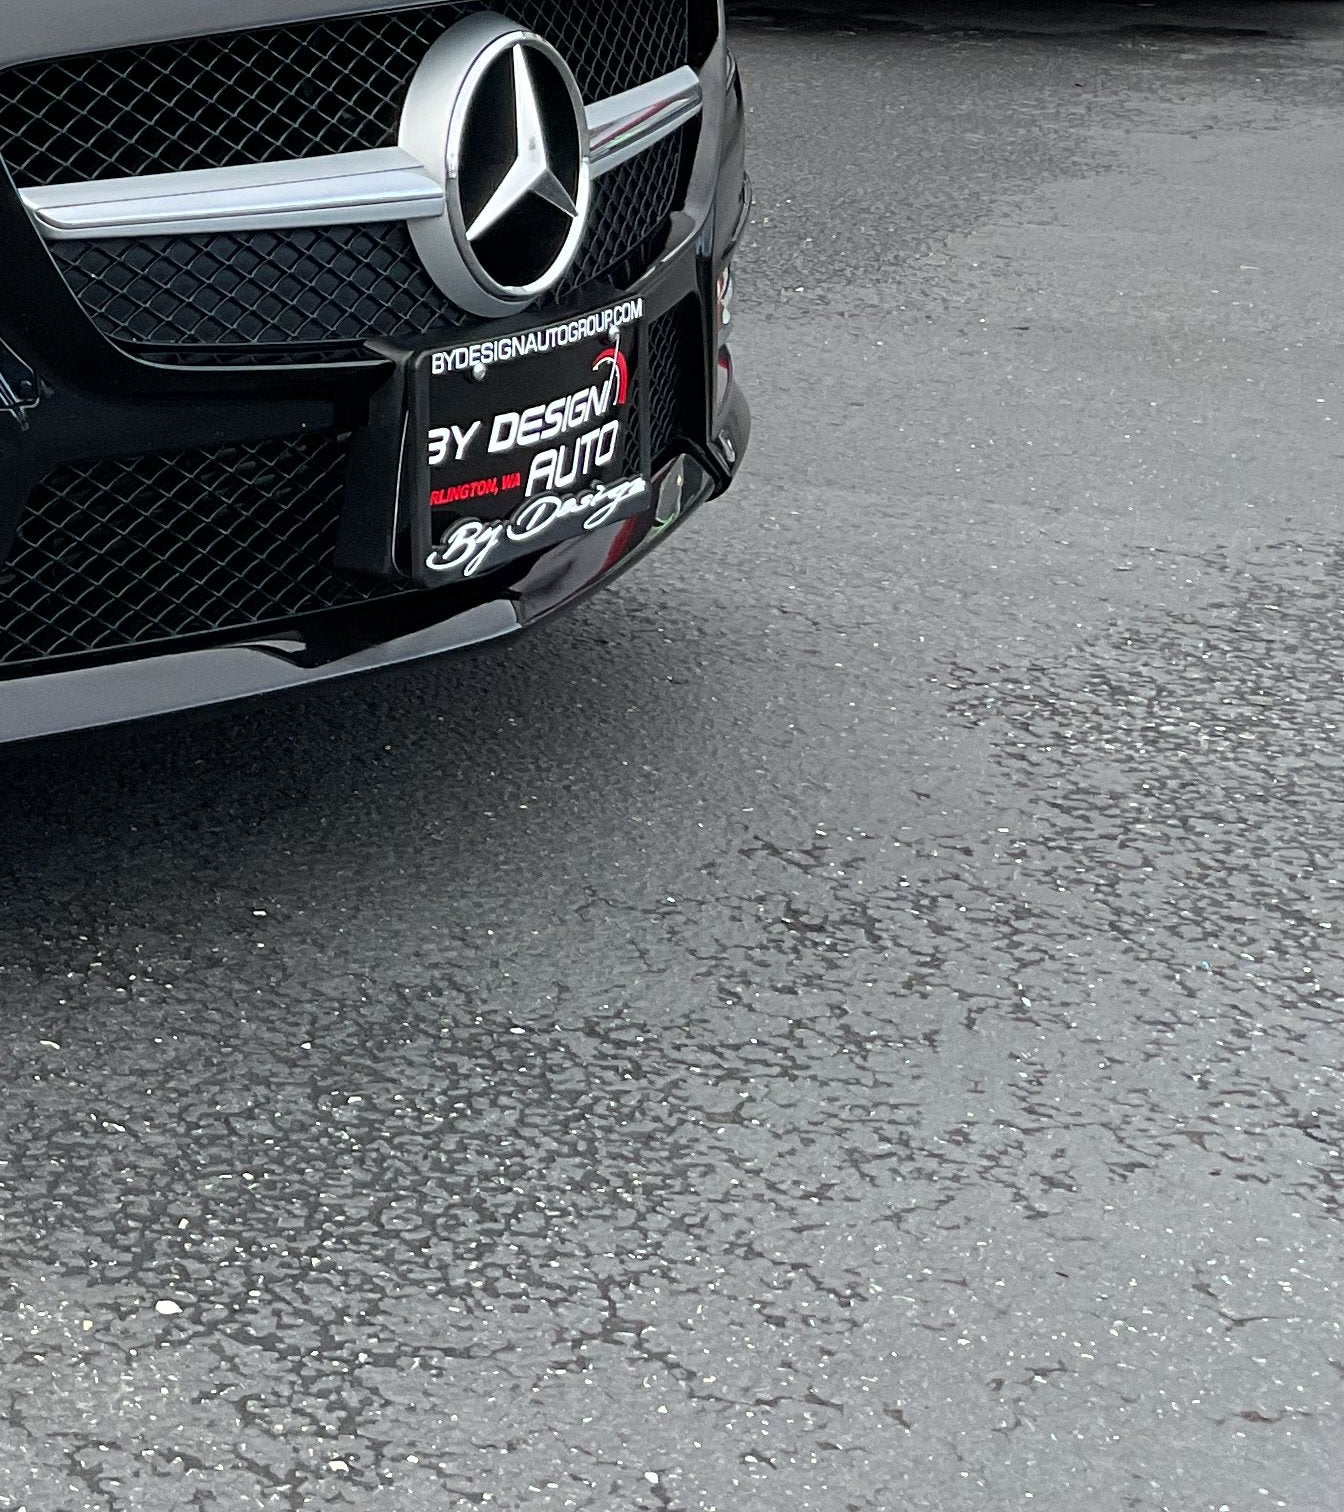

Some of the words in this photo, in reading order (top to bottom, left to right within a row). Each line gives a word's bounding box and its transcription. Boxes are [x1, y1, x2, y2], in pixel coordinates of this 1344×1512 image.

[431, 297, 644, 376] BYDESIGNAUTOGROUP.COM
[487, 379, 611, 454] DESIGN
[429, 477, 499, 506] RLINGTON,
[502, 472, 521, 490] WA
[524, 419, 619, 498] AUTO
[425, 521, 501, 577] By
[506, 476, 647, 540] Design
